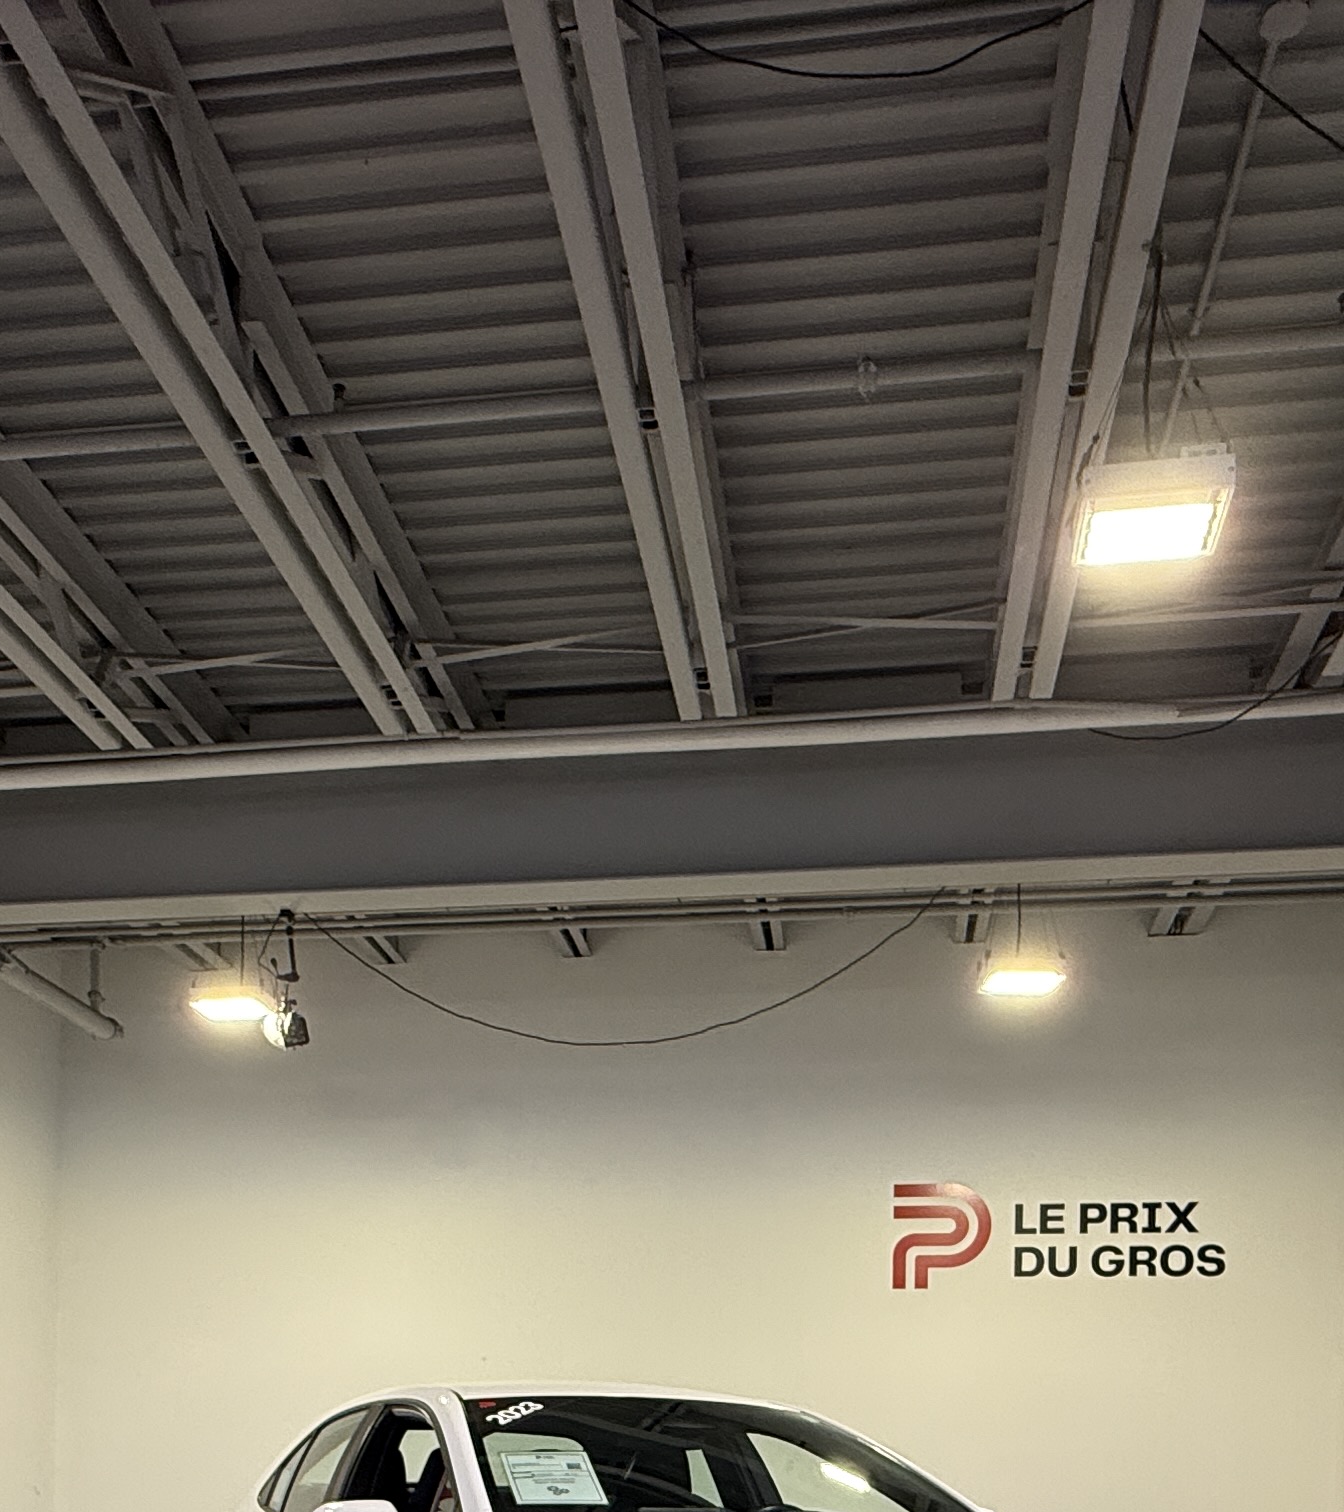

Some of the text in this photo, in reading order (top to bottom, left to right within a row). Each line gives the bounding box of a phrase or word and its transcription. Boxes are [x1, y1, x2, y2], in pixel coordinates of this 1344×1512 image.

[1014, 1201, 1199, 1235] LE PRIX
[1014, 1244, 1226, 1278] DU GROS
[485, 1401, 544, 1425] 2023
